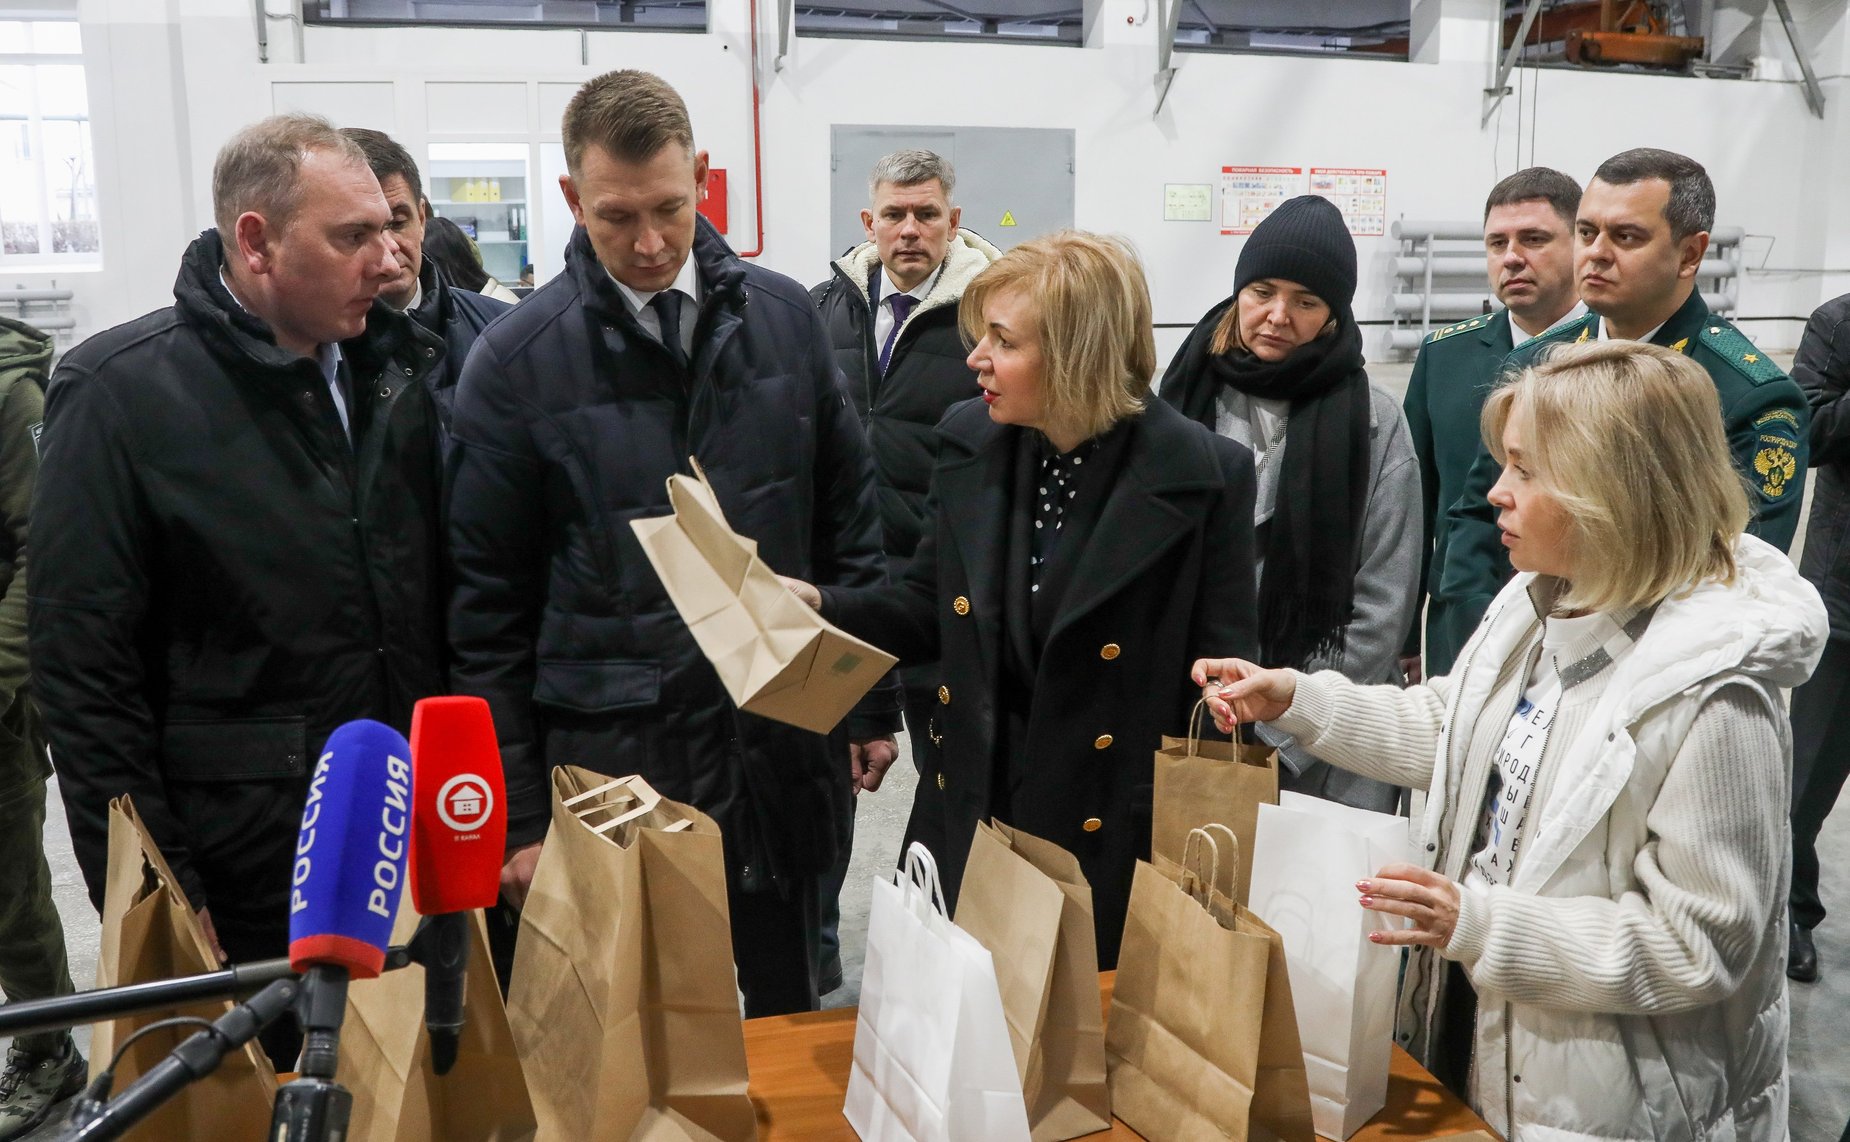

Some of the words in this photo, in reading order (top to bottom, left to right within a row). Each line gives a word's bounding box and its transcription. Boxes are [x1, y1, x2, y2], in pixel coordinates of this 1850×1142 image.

[291, 751, 334, 915] РОССИЯ
[367, 754, 410, 919] РОССИЯ
[1496, 747, 1531, 786] ИРОД
